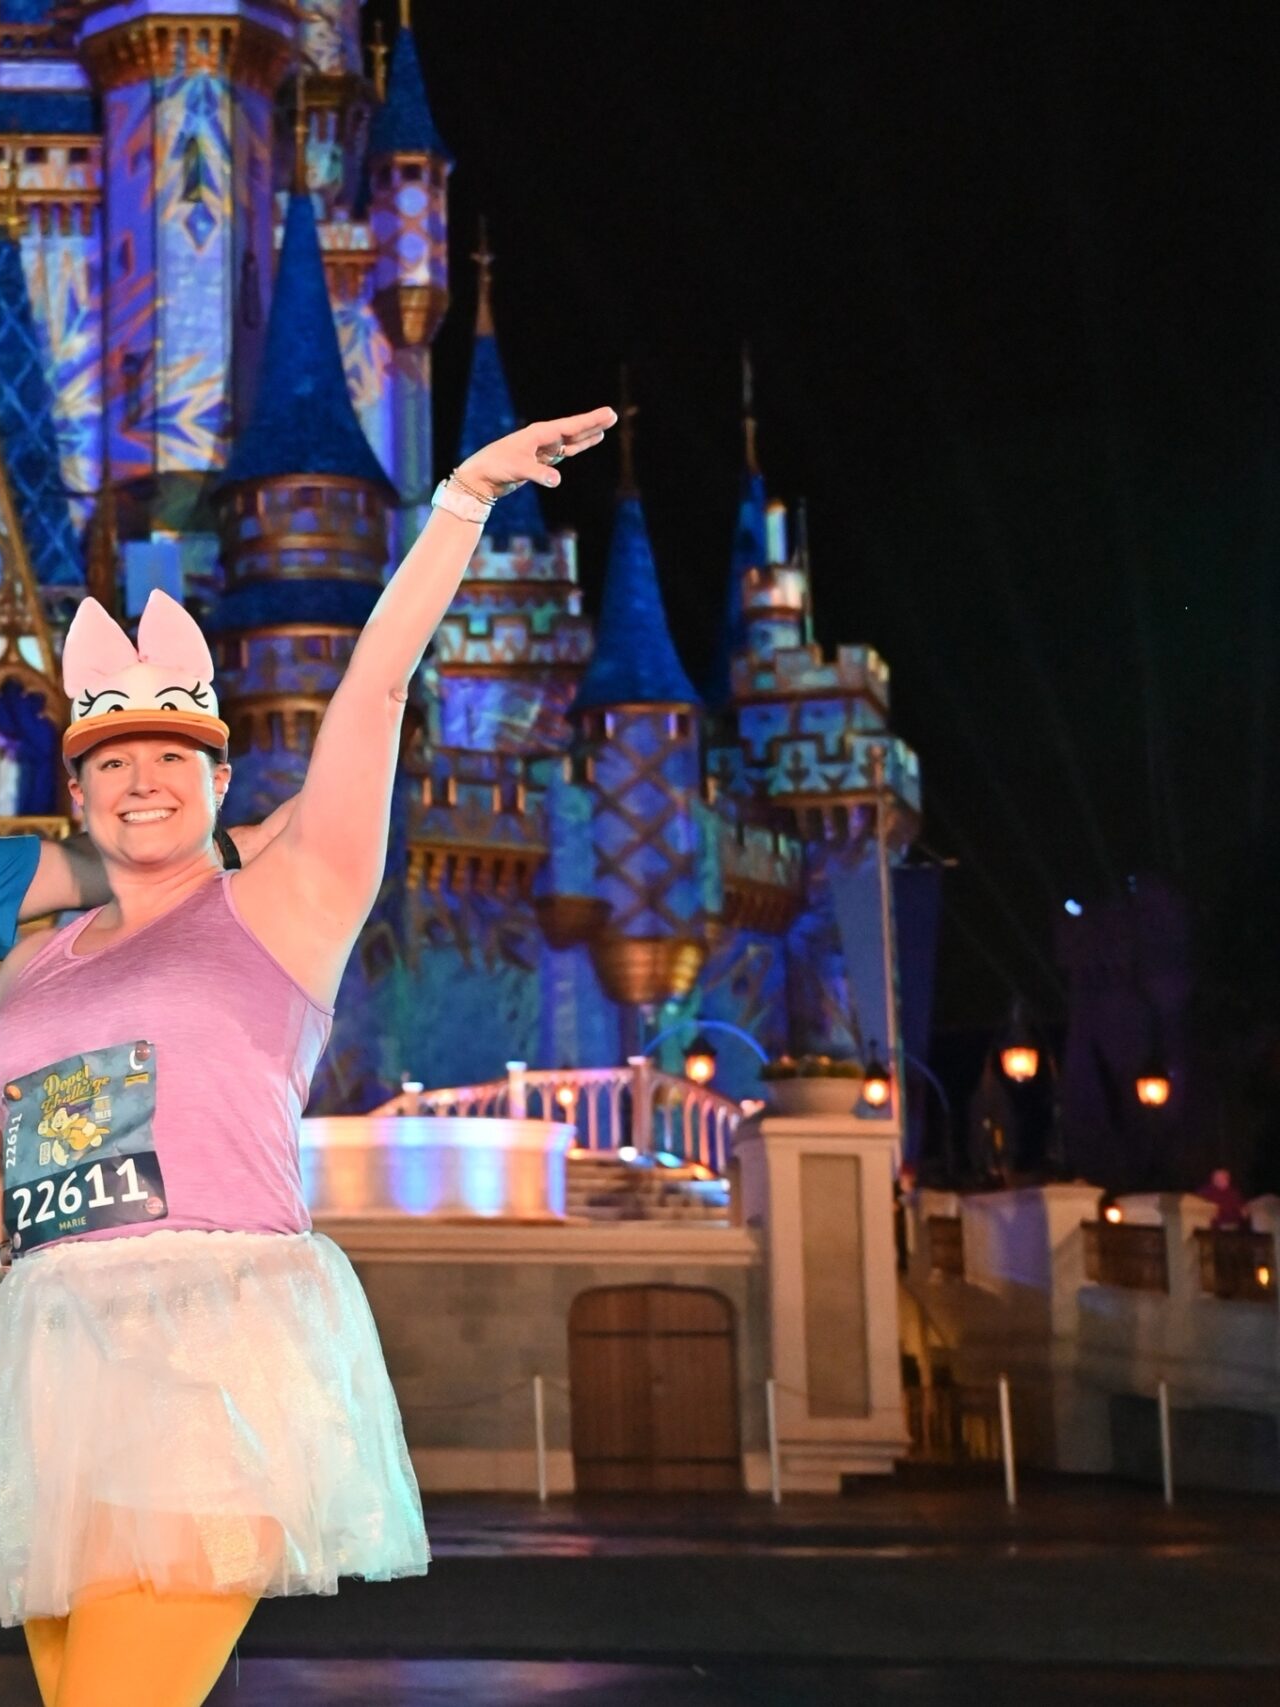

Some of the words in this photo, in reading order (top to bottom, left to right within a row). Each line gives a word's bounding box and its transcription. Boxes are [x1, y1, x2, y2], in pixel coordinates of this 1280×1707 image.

[6, 1113, 23, 1168] 22611
[12, 1158, 149, 1230] 22611
[58, 1216, 87, 1231] MARIE
